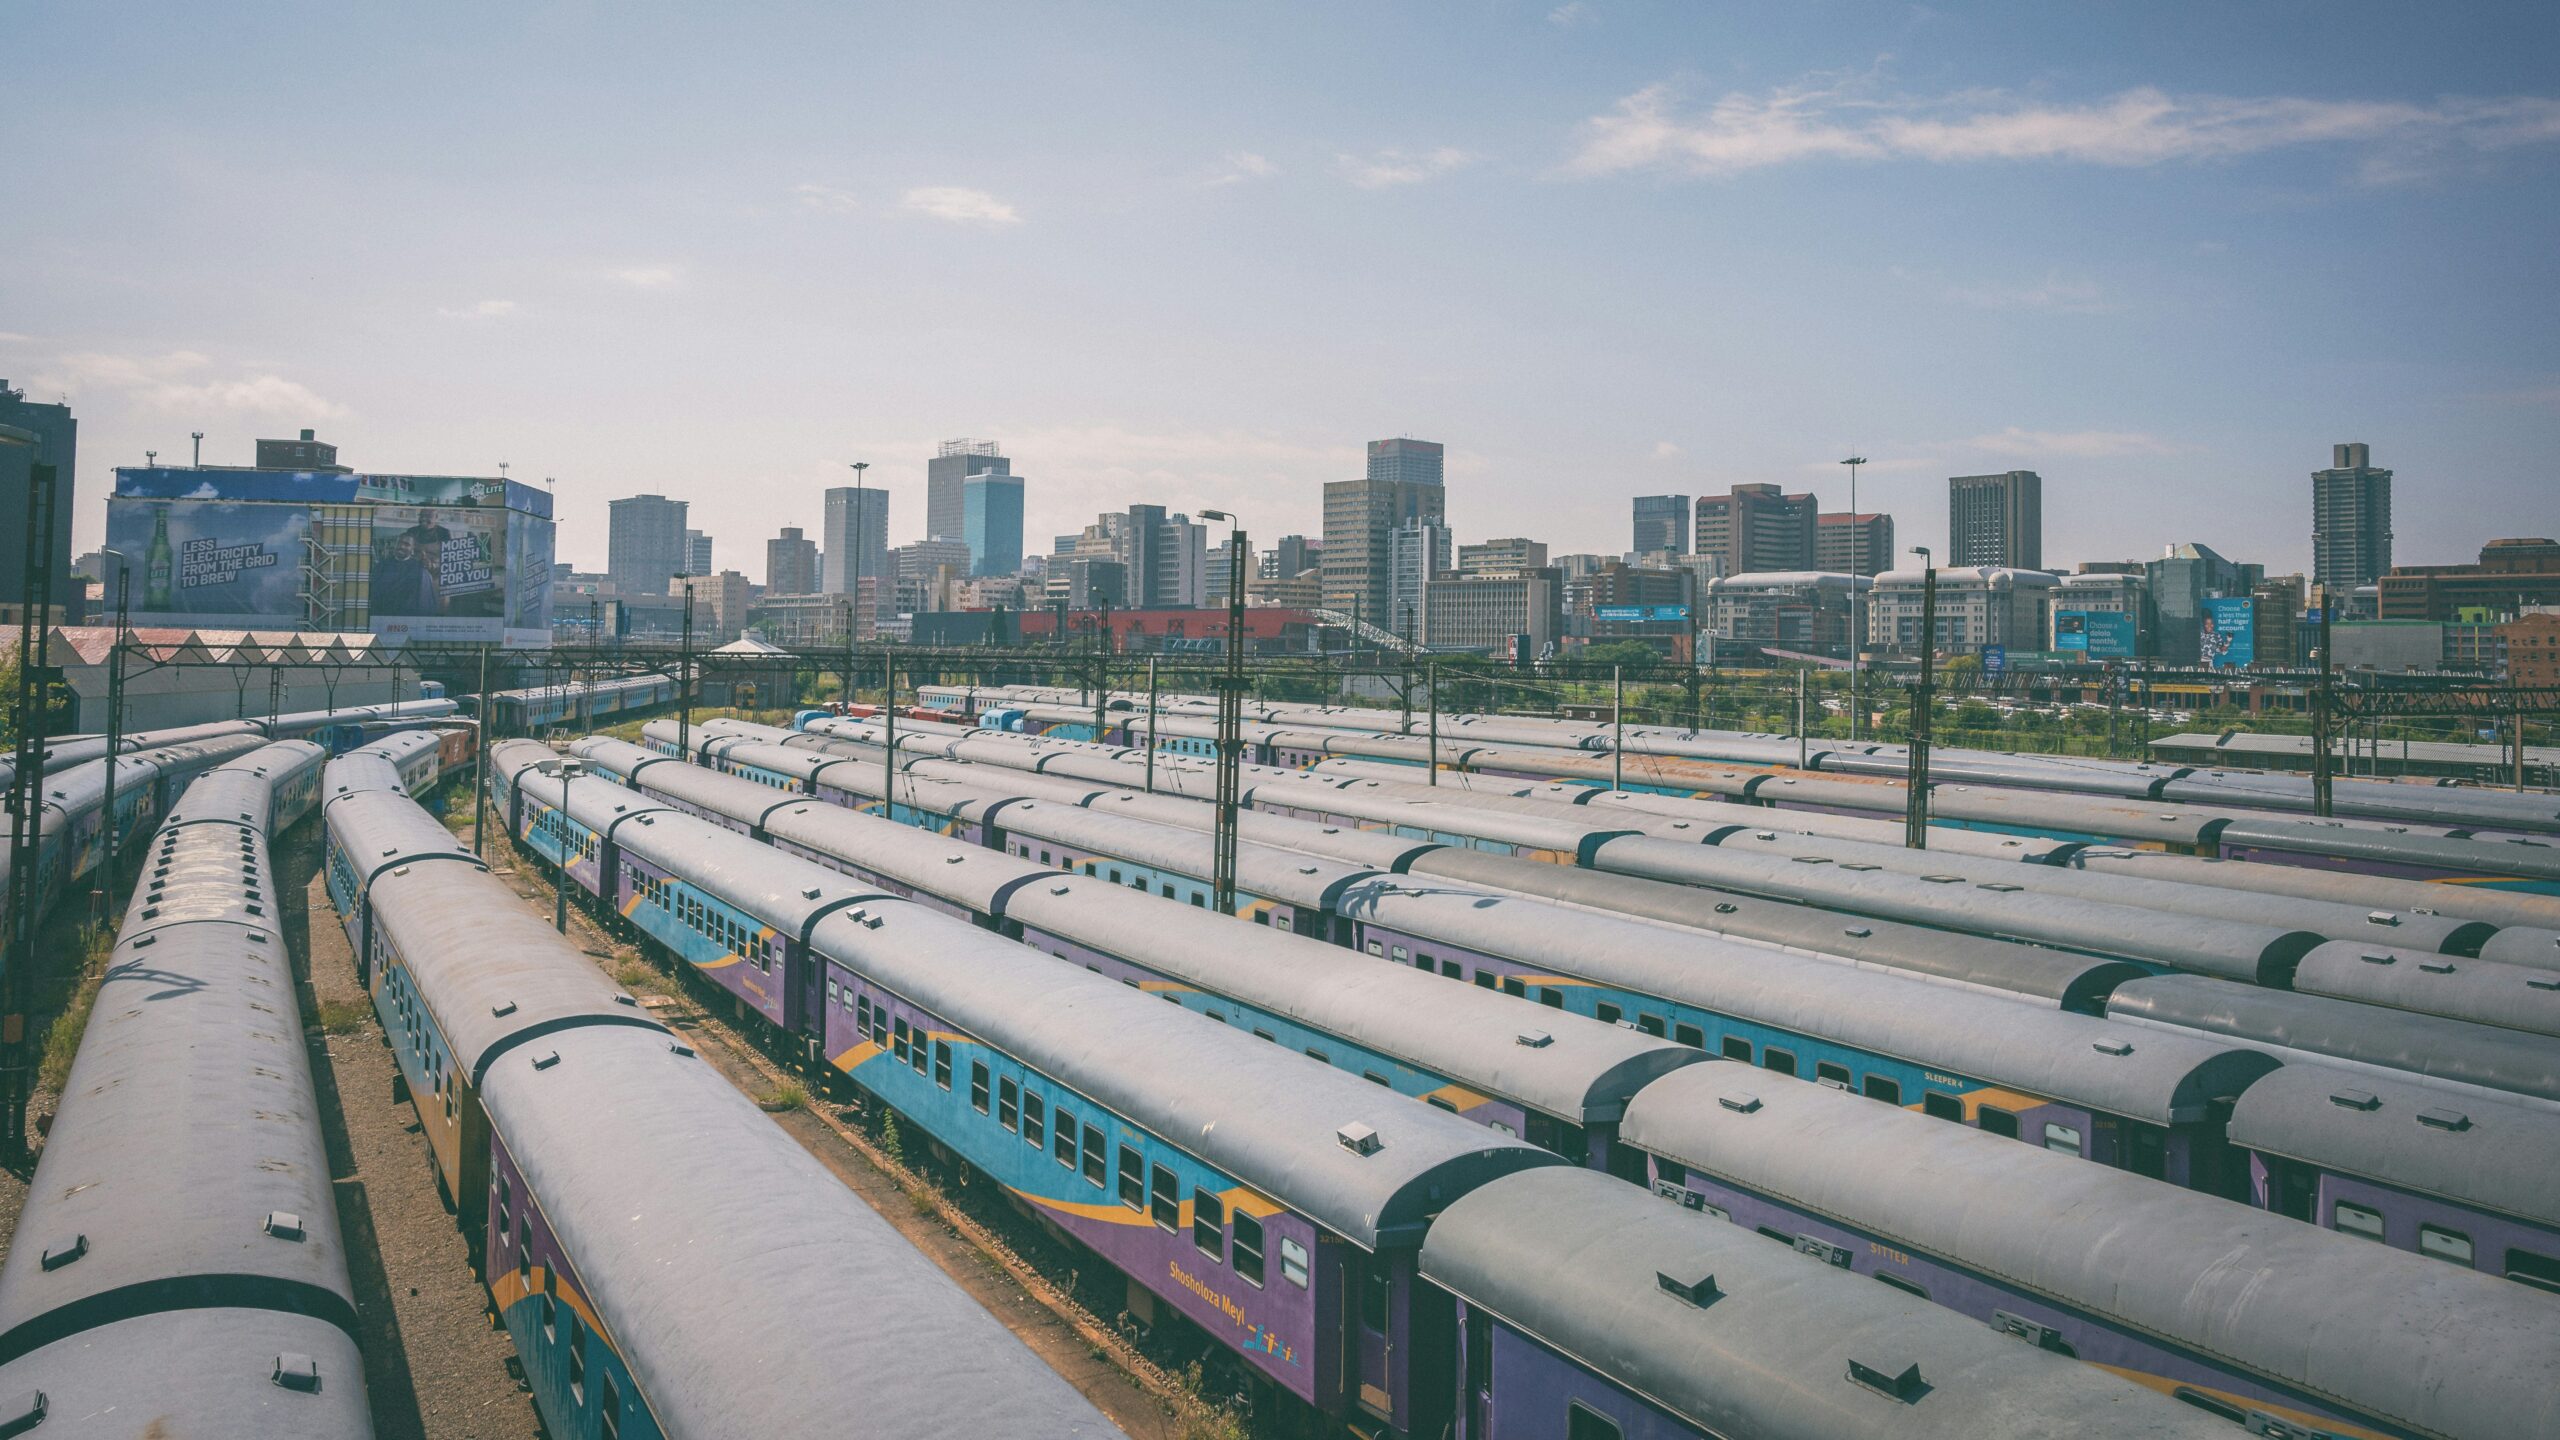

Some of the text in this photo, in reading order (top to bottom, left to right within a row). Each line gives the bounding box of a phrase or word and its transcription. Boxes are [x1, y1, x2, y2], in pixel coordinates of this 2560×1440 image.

[486, 485, 504, 494] LITE
[183, 539, 215, 553] LESS
[441, 537, 475, 551] MORE
[183, 544, 260, 564] ELECTRICITY
[440, 547, 480, 562] FRESH
[182, 554, 275, 577] FROM THE GRID
[440, 560, 472, 574] CUTS
[182, 570, 236, 588] TO BREW
[440, 568, 490, 585] FOR YOU
[2089, 621, 2113, 629] Choose
[2089, 638, 2118, 646] monthly
[1924, 1072, 1963, 1088] SLEEPER 4
[1870, 1242, 1909, 1265] SITTER
[1169, 1260, 1245, 1327] Shosholoza Meyl
